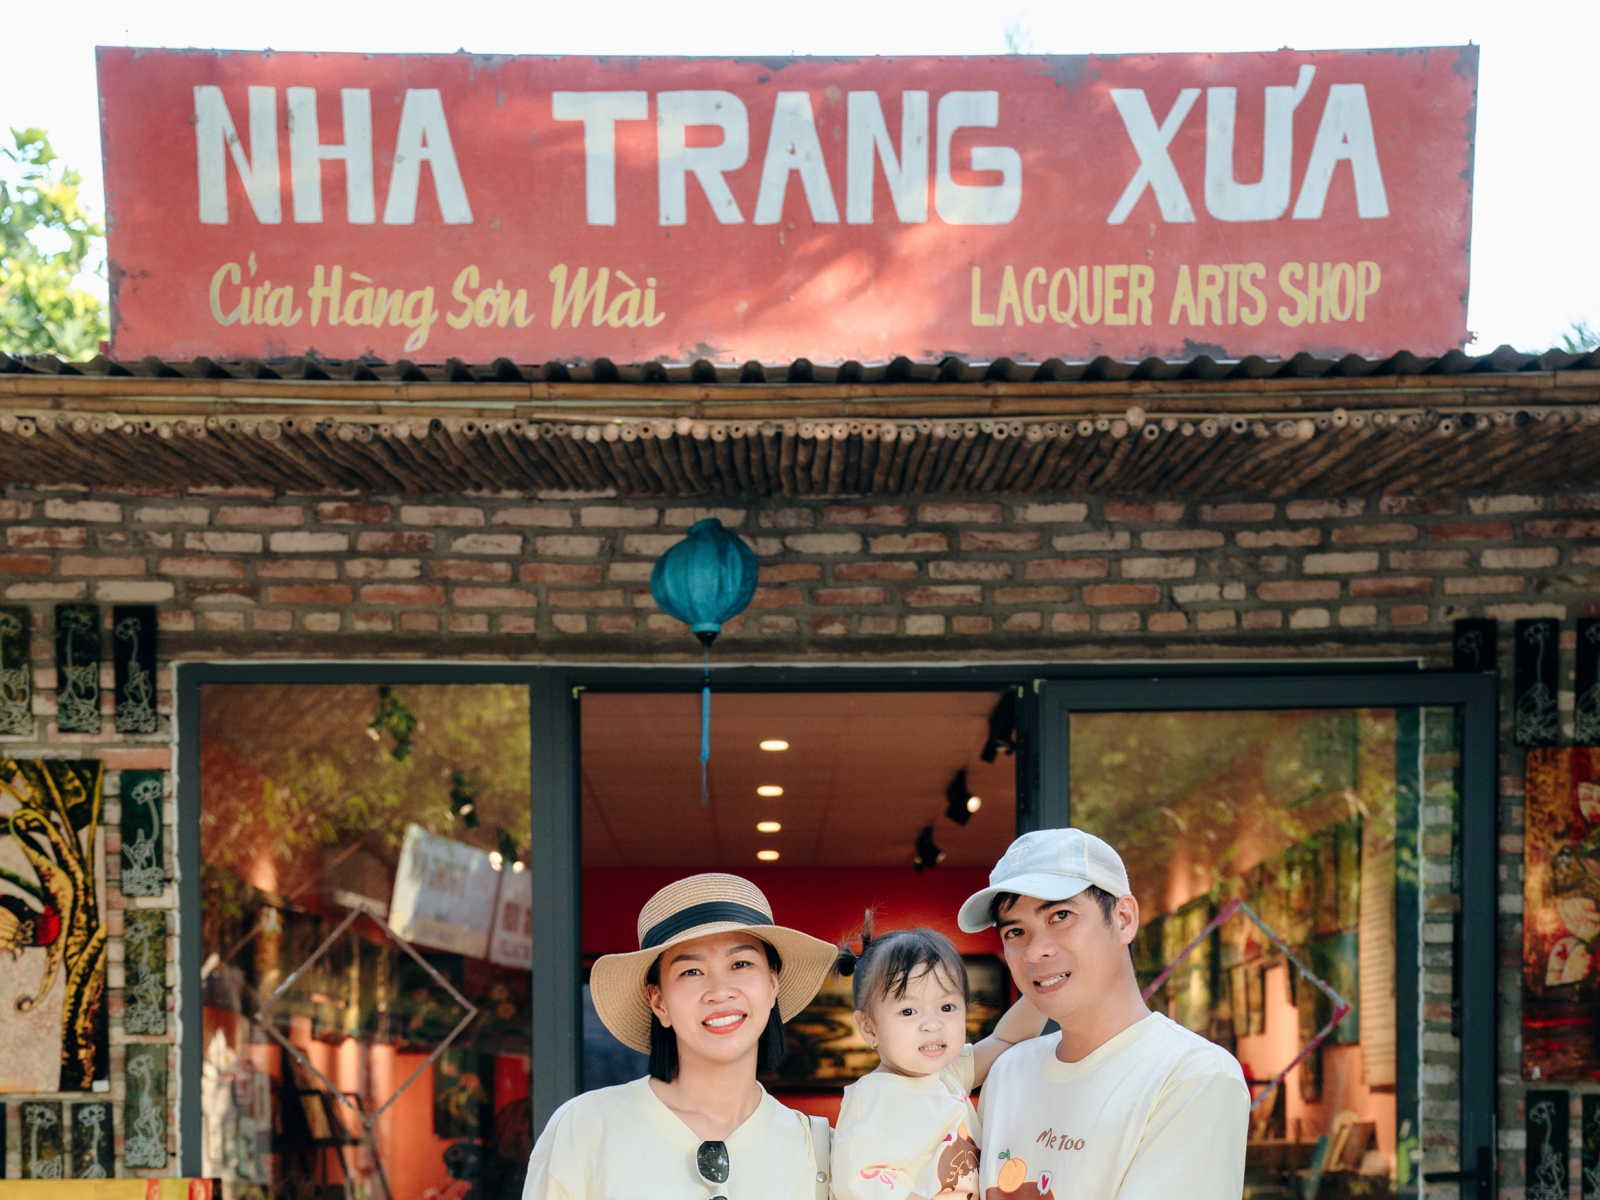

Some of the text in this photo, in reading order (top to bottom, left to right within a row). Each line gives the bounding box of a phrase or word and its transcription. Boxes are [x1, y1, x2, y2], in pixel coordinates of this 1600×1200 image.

[194, 65, 1390, 225] NHA TRANG XƯA
[210, 251, 665, 351] Cửa Hàng Sơn Mài
[971, 261, 1382, 328] LACQUER ARTS SHOP
[1036, 1127, 1086, 1151] Me Too
